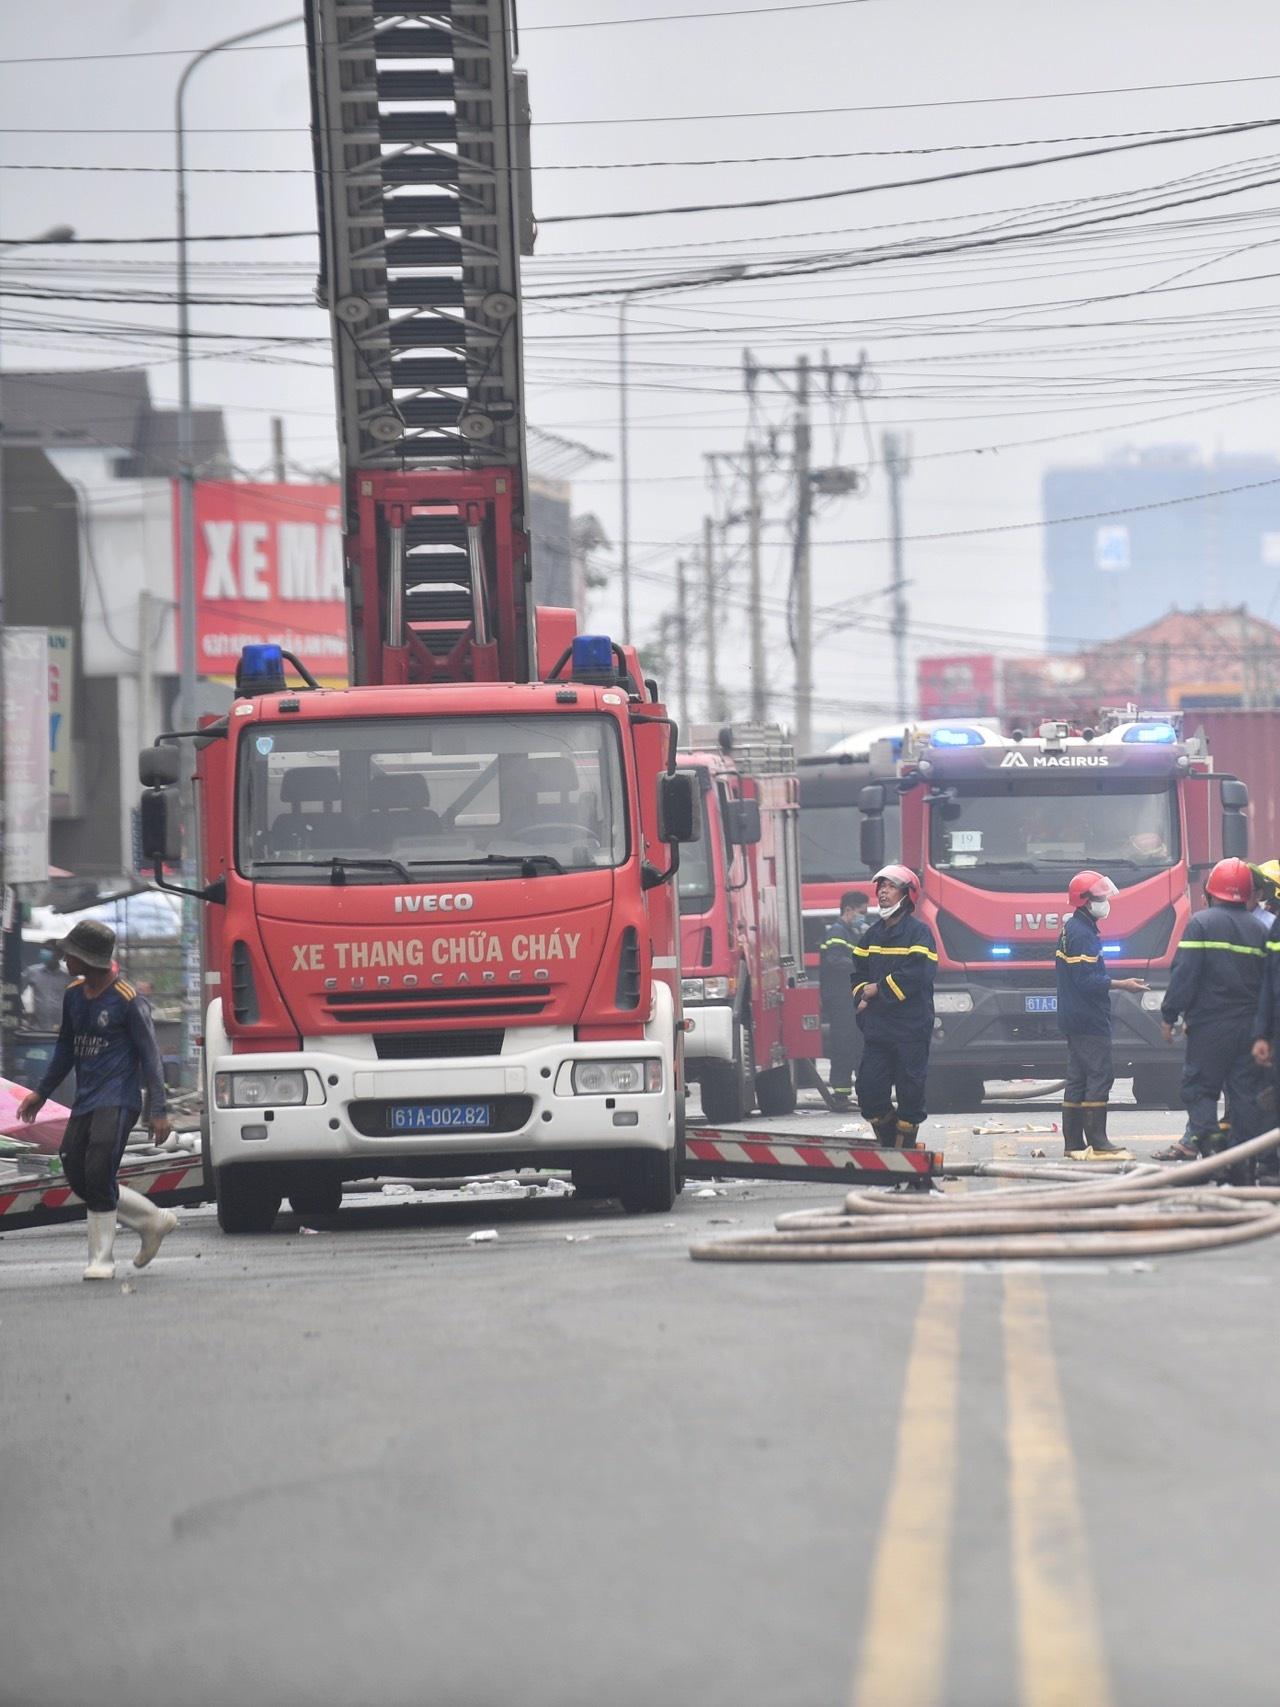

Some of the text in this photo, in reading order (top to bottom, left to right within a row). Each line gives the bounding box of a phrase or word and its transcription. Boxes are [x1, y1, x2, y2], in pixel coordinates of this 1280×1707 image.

[203, 507, 345, 599] XE MÁ
[1033, 756, 1109, 767] MAGIRUS
[961, 834, 973, 845] 19
[394, 893, 474, 912] IVECO
[292, 927, 581, 971] XE THANG CHỮA CHÁY
[324, 968, 550, 989] EUROCARGO
[1028, 998, 1057, 1010] 61A-0
[395, 1107, 486, 1126] 61A-002.82
